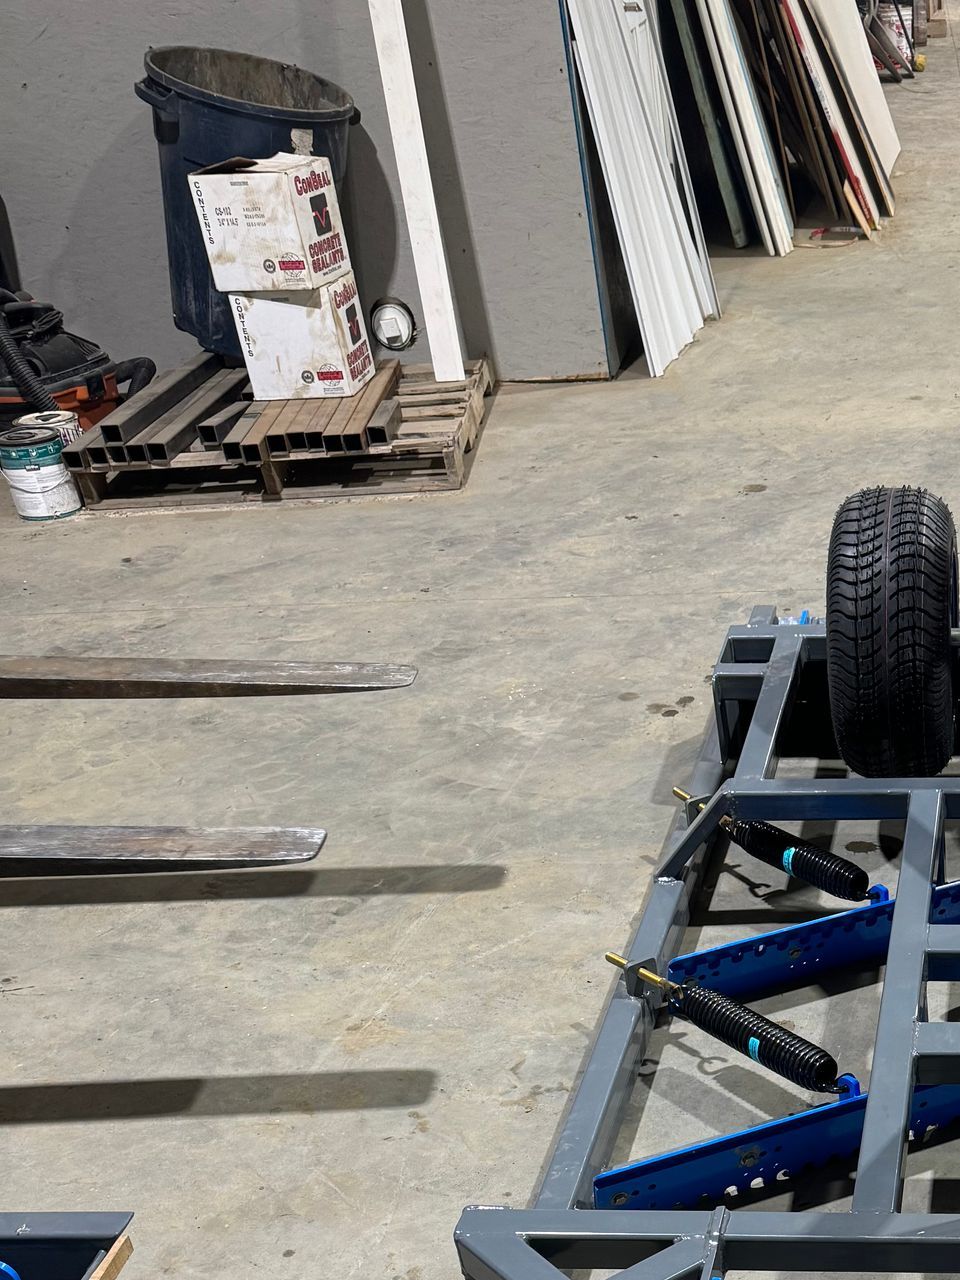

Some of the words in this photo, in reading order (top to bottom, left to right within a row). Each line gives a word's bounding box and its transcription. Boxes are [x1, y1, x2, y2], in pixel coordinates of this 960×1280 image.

[193, 181, 215, 245] CONTENTS
[309, 232, 342, 259] CONCRETE
[312, 247, 344, 274] SEALANTS
[234, 298, 254, 357] CONTENTS
